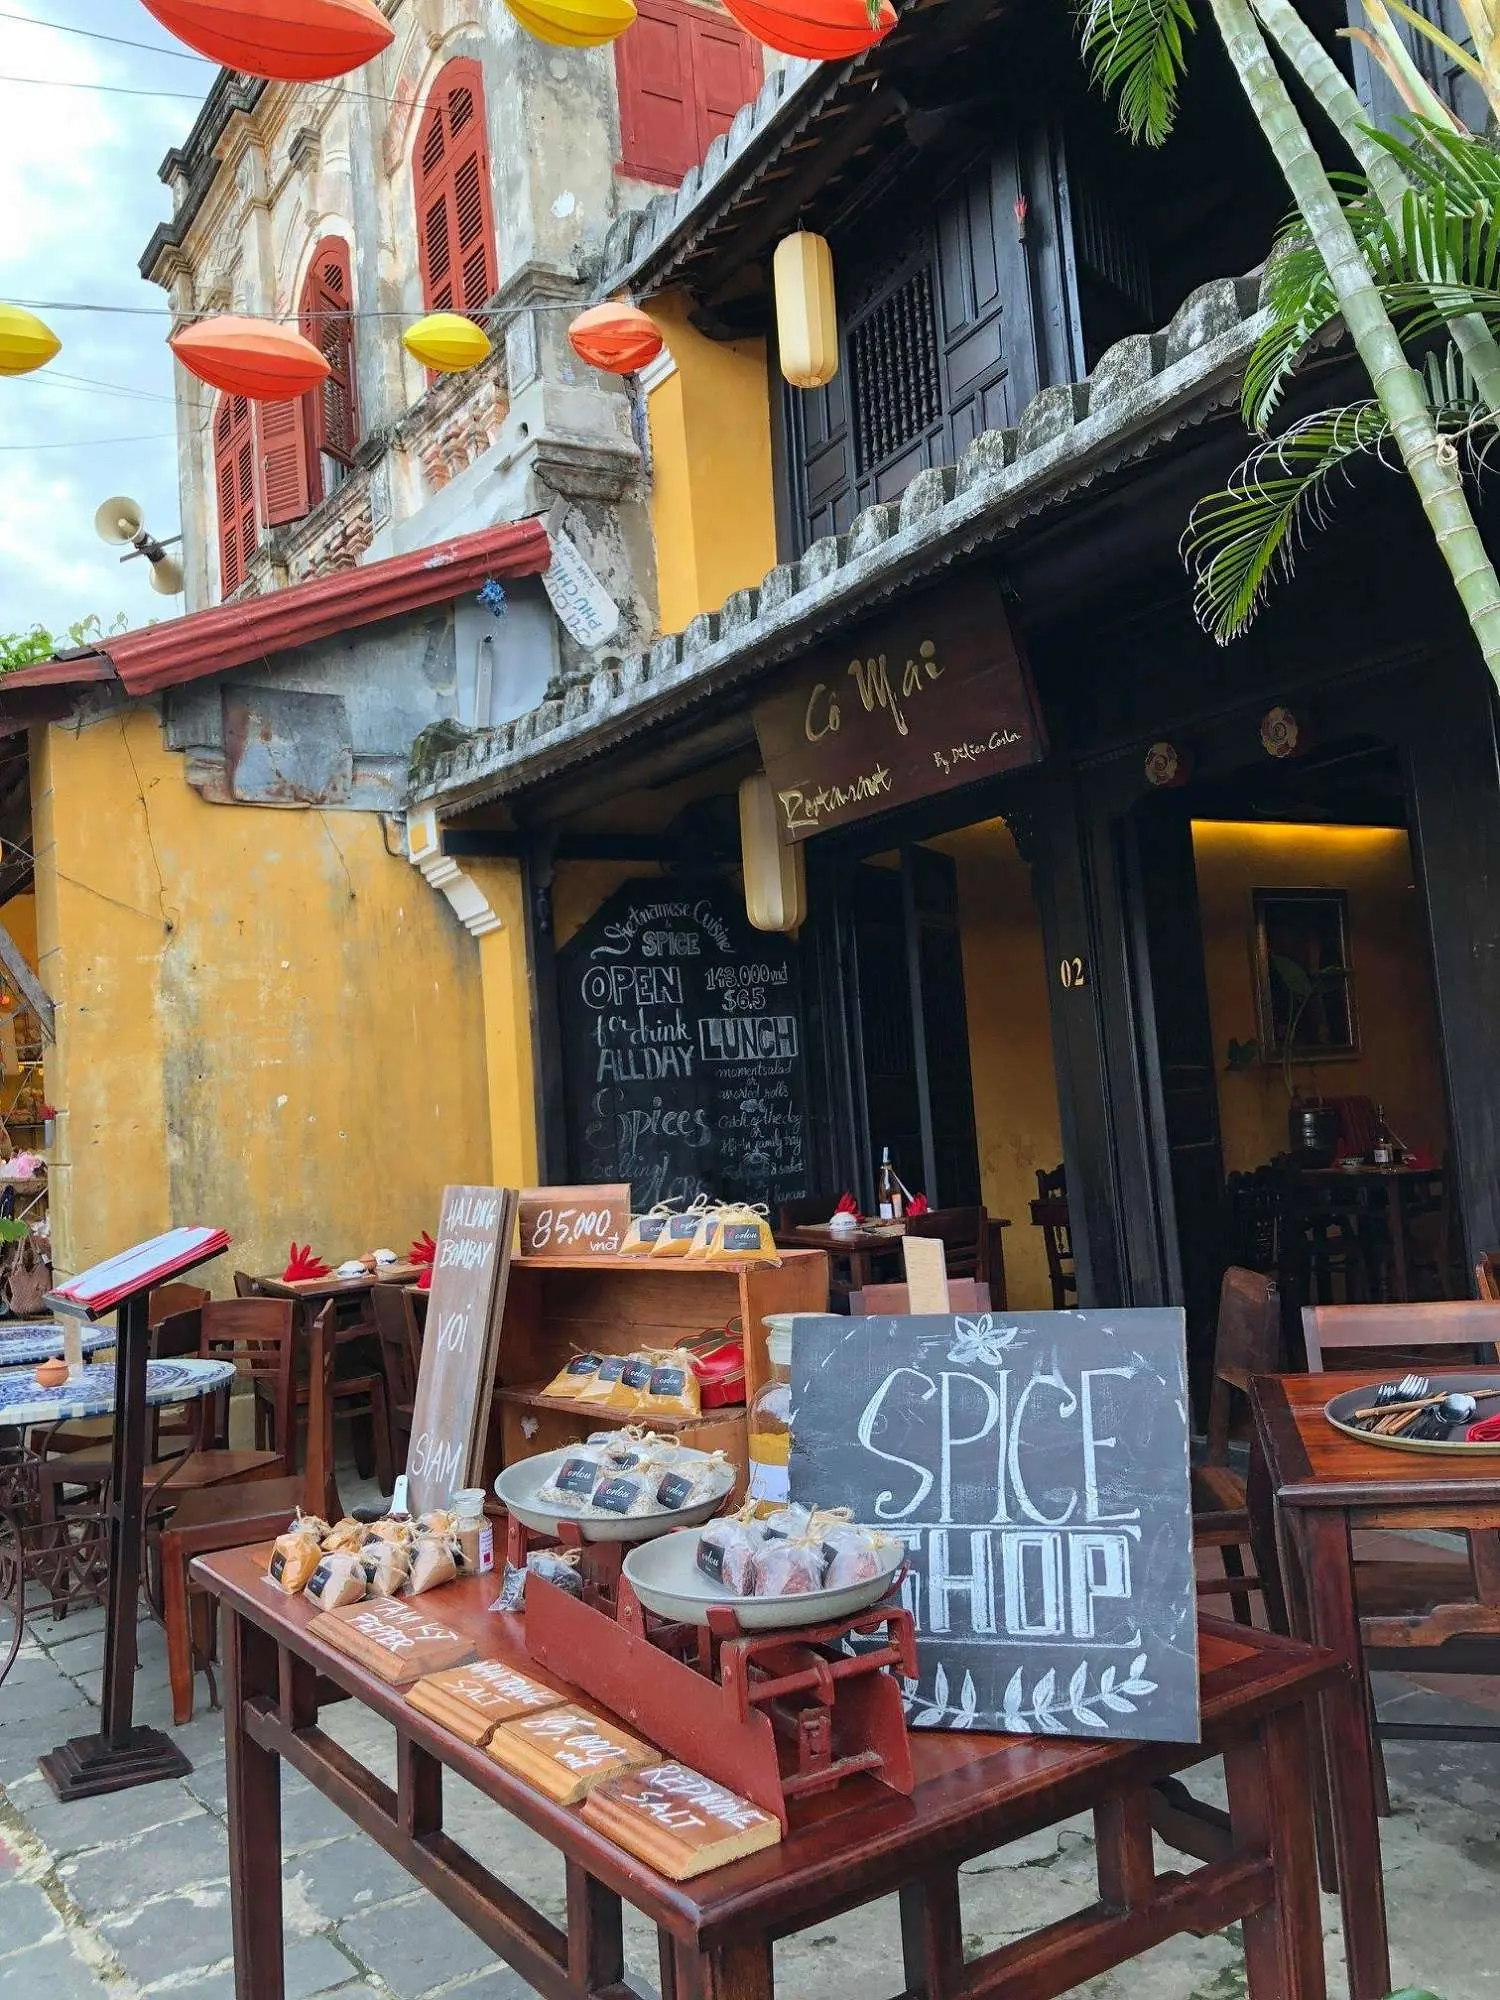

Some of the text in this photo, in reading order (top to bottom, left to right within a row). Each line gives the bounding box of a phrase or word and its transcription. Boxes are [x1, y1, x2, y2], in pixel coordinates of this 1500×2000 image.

[848, 640, 945, 736] Mai
[641, 930, 701, 957] SPICE
[581, 966, 684, 1009] OPEN
[1061, 957, 1084, 988] 02
[700, 1017, 798, 1060] LUNCH
[585, 1087, 713, 1157] Spices
[440, 1239, 493, 1270] BOMBAY
[412, 1431, 462, 1492] SIAM
[858, 1366, 1141, 1525] SPICE
[374, 1597, 424, 1625] TAM
[345, 1612, 416, 1652] PEPPER
[442, 1680, 511, 1706] SALT
[621, 1791, 706, 1829] SALT
